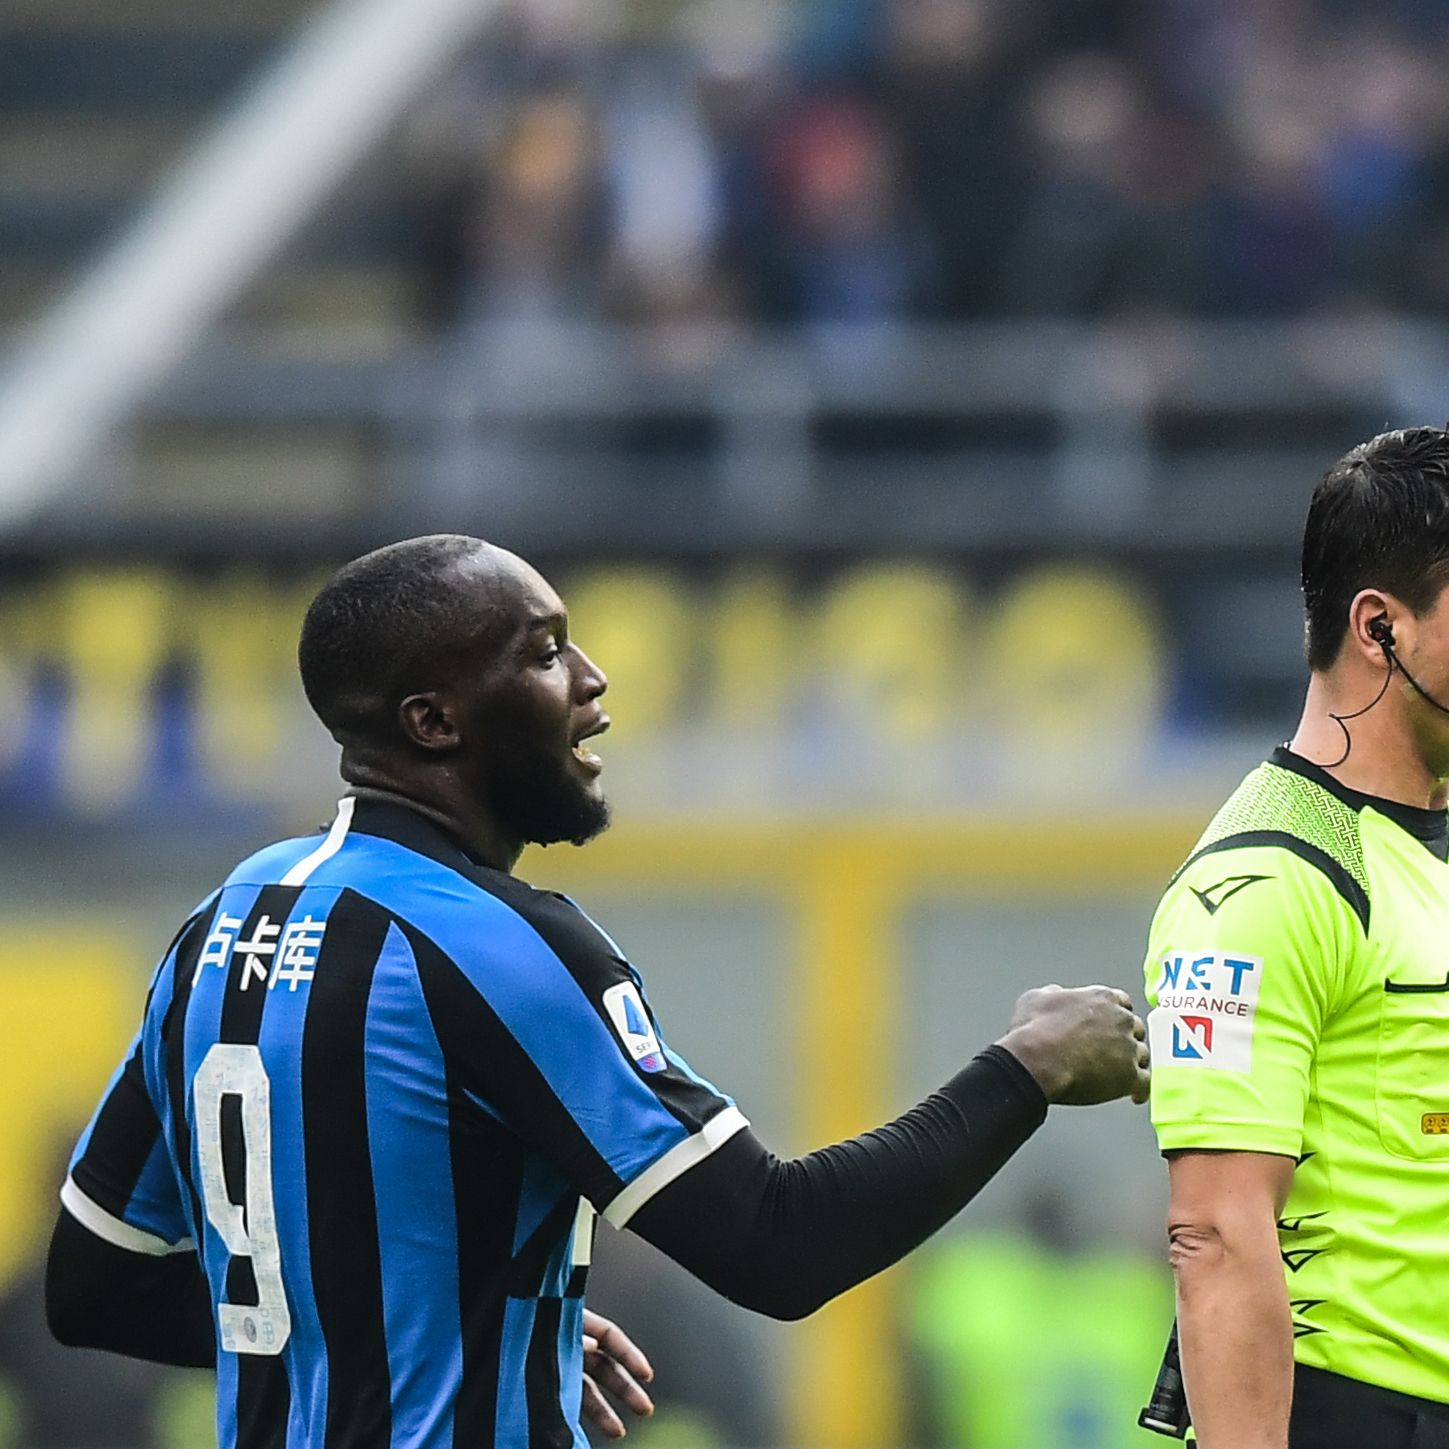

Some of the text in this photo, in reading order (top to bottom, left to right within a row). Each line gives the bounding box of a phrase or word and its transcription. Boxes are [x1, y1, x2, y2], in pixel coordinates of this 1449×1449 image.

[191, 912, 327, 992] 卢卡库
[1158, 957, 1255, 996] NET
[193, 1043, 291, 1356] 9
